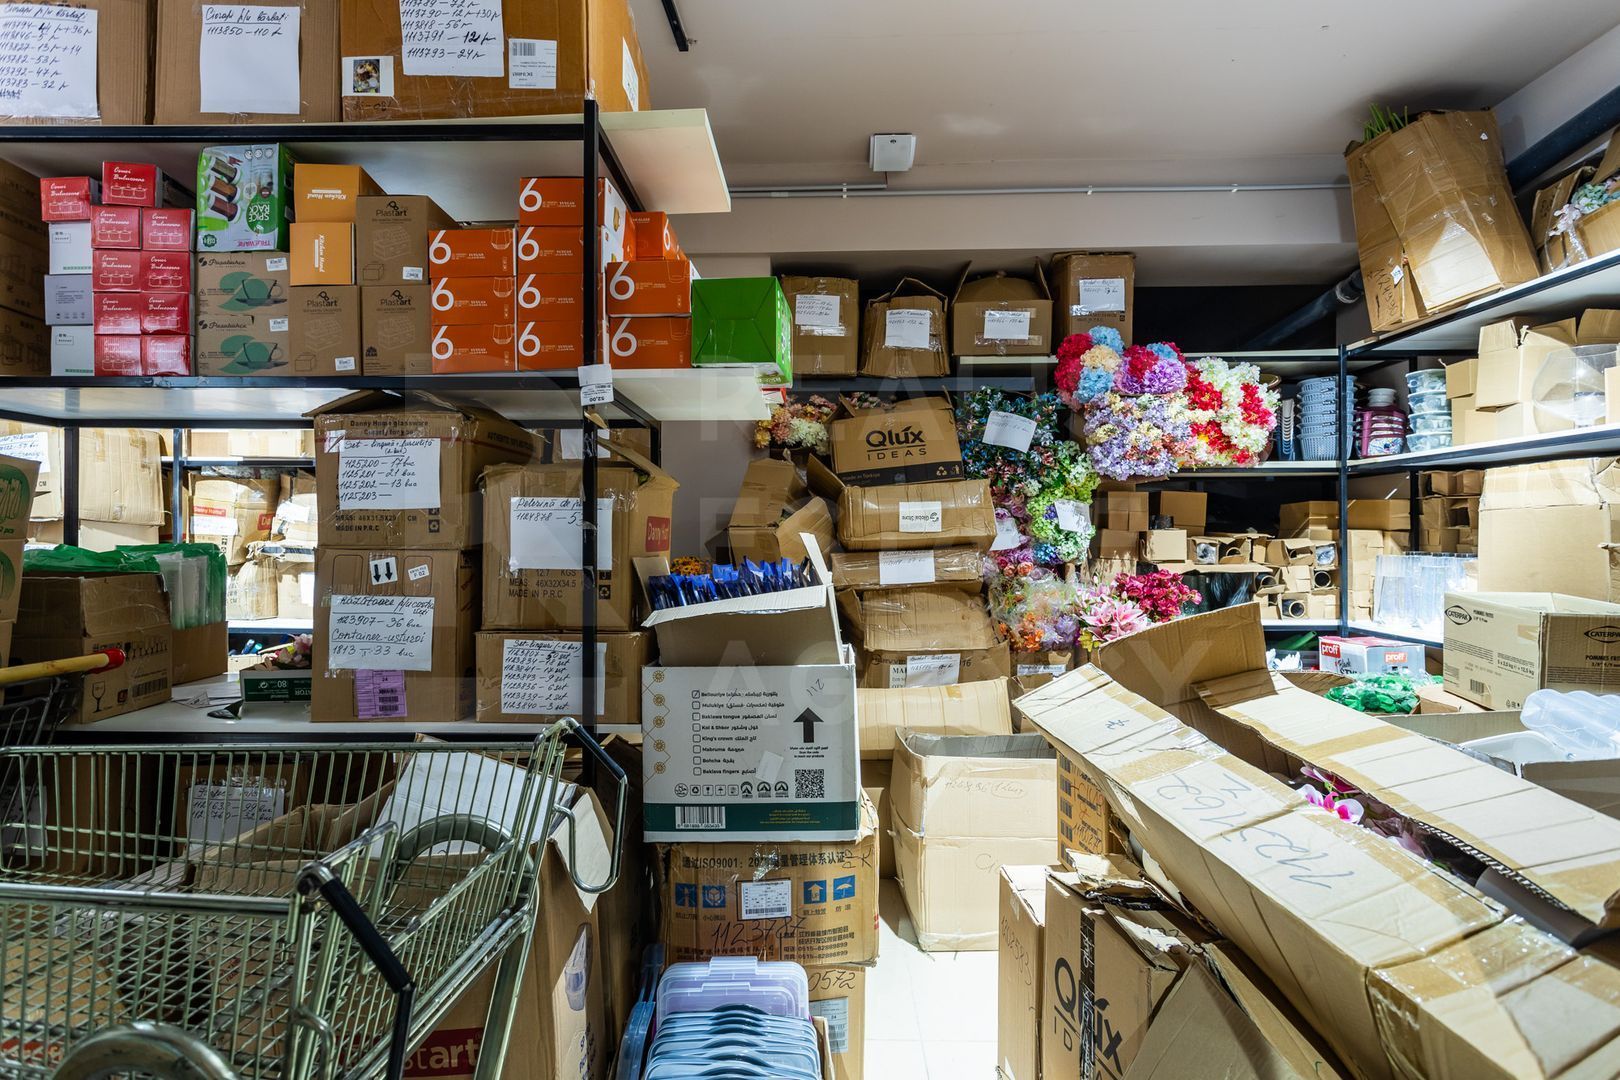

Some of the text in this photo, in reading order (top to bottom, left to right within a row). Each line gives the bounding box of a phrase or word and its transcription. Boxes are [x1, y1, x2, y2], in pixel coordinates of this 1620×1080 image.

[250, 203, 270, 213] RACK
[519, 178, 542, 212] 6
[249, 213, 270, 222] SPICE
[429, 230, 451, 264] 6
[518, 226, 540, 261] 6
[431, 278, 454, 312] 6
[518, 274, 541, 309] 6
[609, 261, 635, 300] 6
[431, 325, 454, 360] 6
[518, 321, 541, 357] 6
[611, 318, 638, 357] 6
[866, 426, 926, 447] Qlúx
[867, 448, 927, 461] IDEAS
[1322, 644, 1338, 656] proff
[1385, 653, 1405, 661] proff
[277, 680, 287, 688] 80
